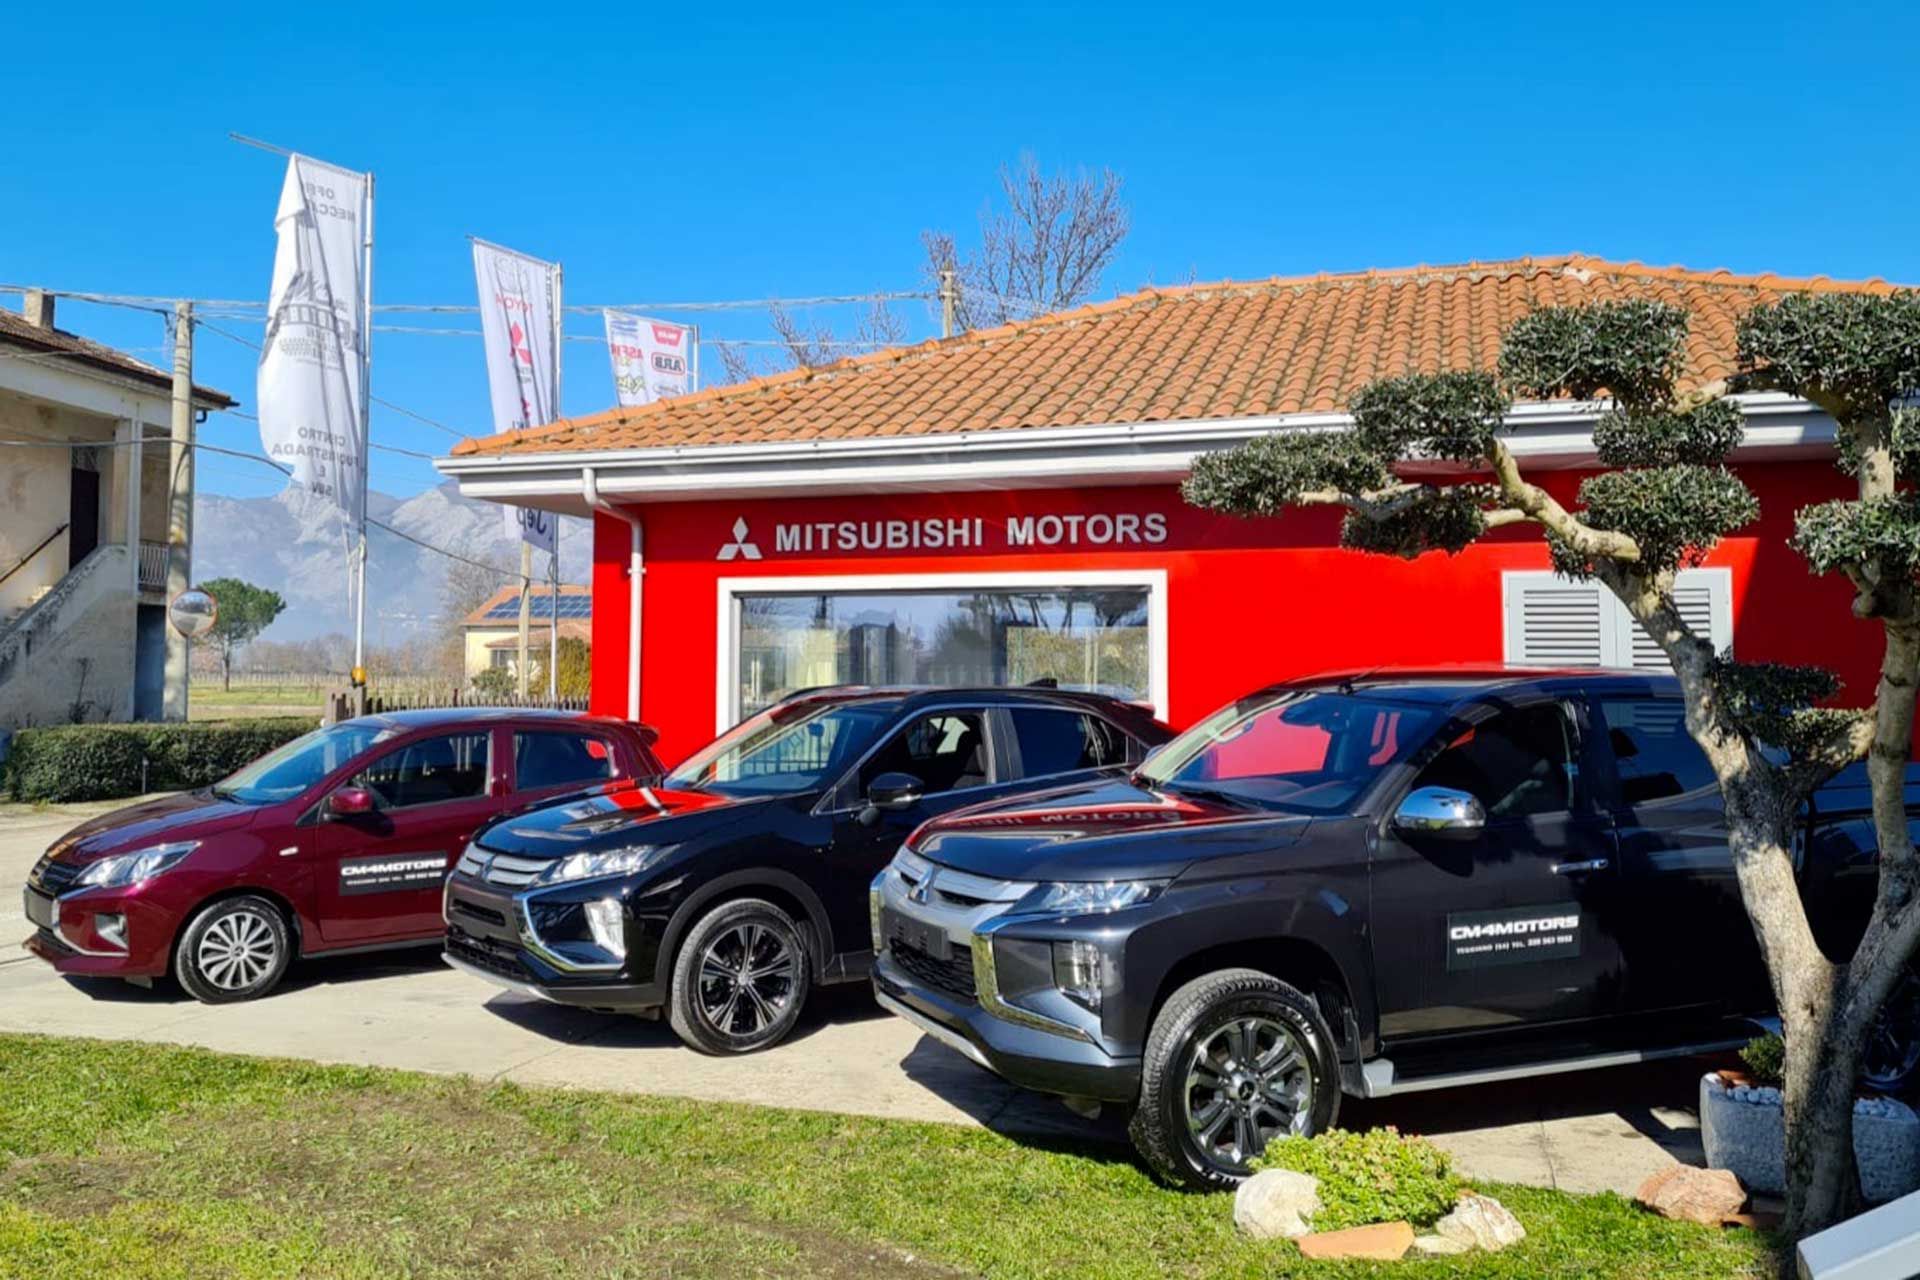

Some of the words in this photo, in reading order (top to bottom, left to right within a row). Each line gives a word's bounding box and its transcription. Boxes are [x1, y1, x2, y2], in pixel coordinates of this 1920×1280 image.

[775, 517, 983, 552] MITSUBISHI
[1007, 513, 1168, 545] MOTORS
[341, 859, 447, 876] CM4MOTORS
[1450, 915, 1579, 940] CM4MOTORS
